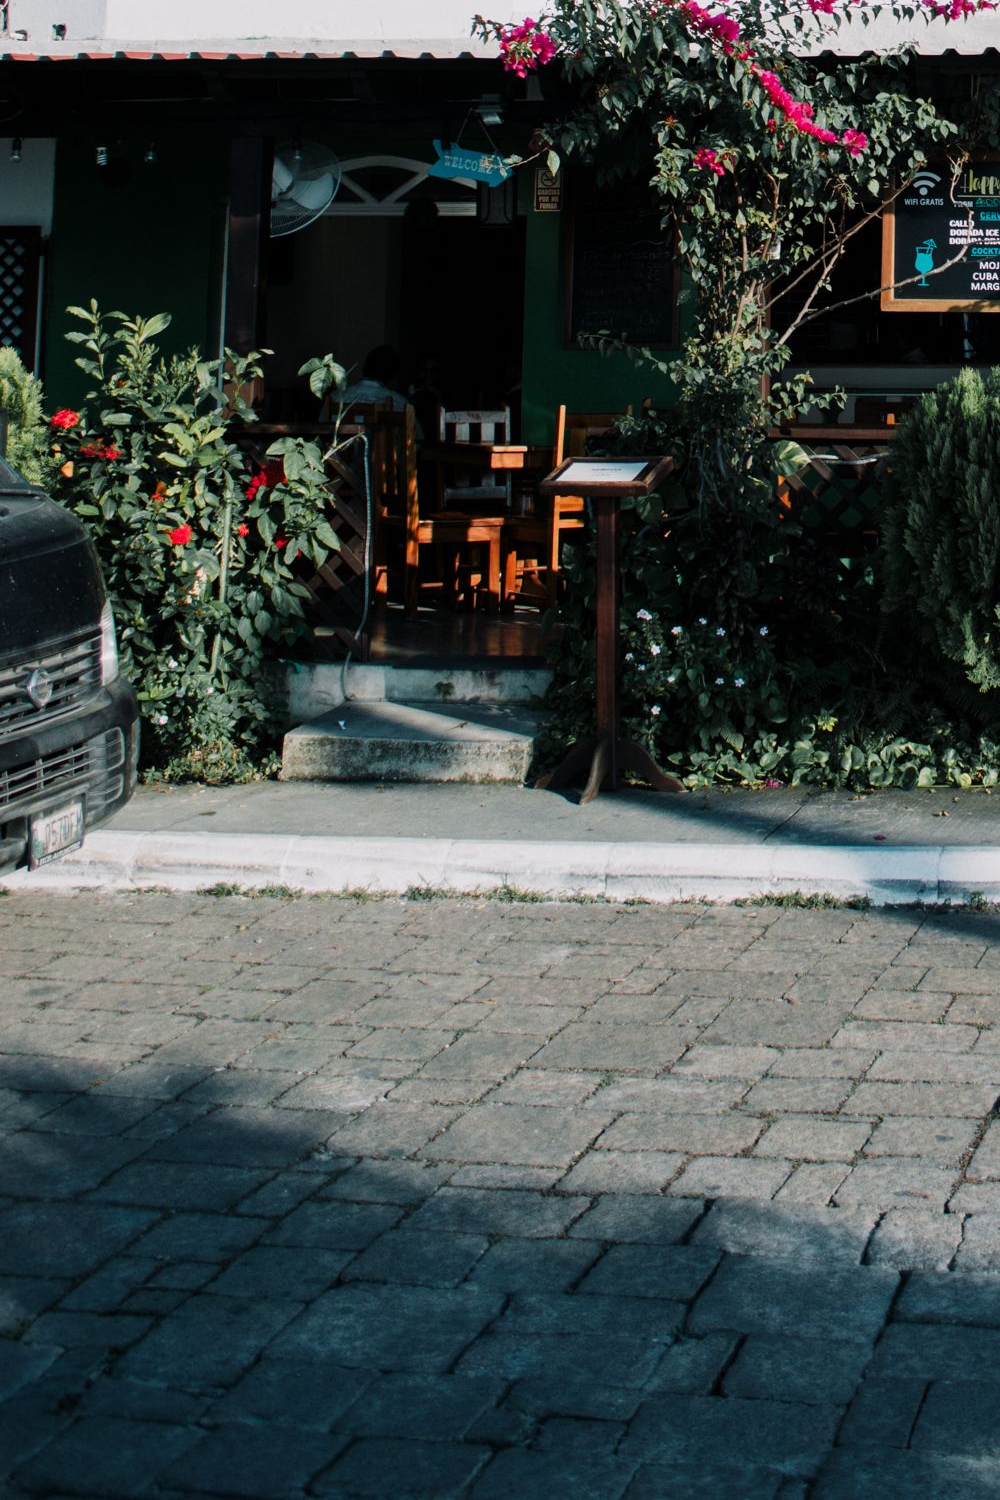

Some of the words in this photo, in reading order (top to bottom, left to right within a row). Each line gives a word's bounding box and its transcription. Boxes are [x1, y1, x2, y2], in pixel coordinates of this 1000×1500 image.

[949, 229, 984, 237] DORADA
[985, 229, 1000, 237] ICE
[972, 272, 999, 280] CUBA
